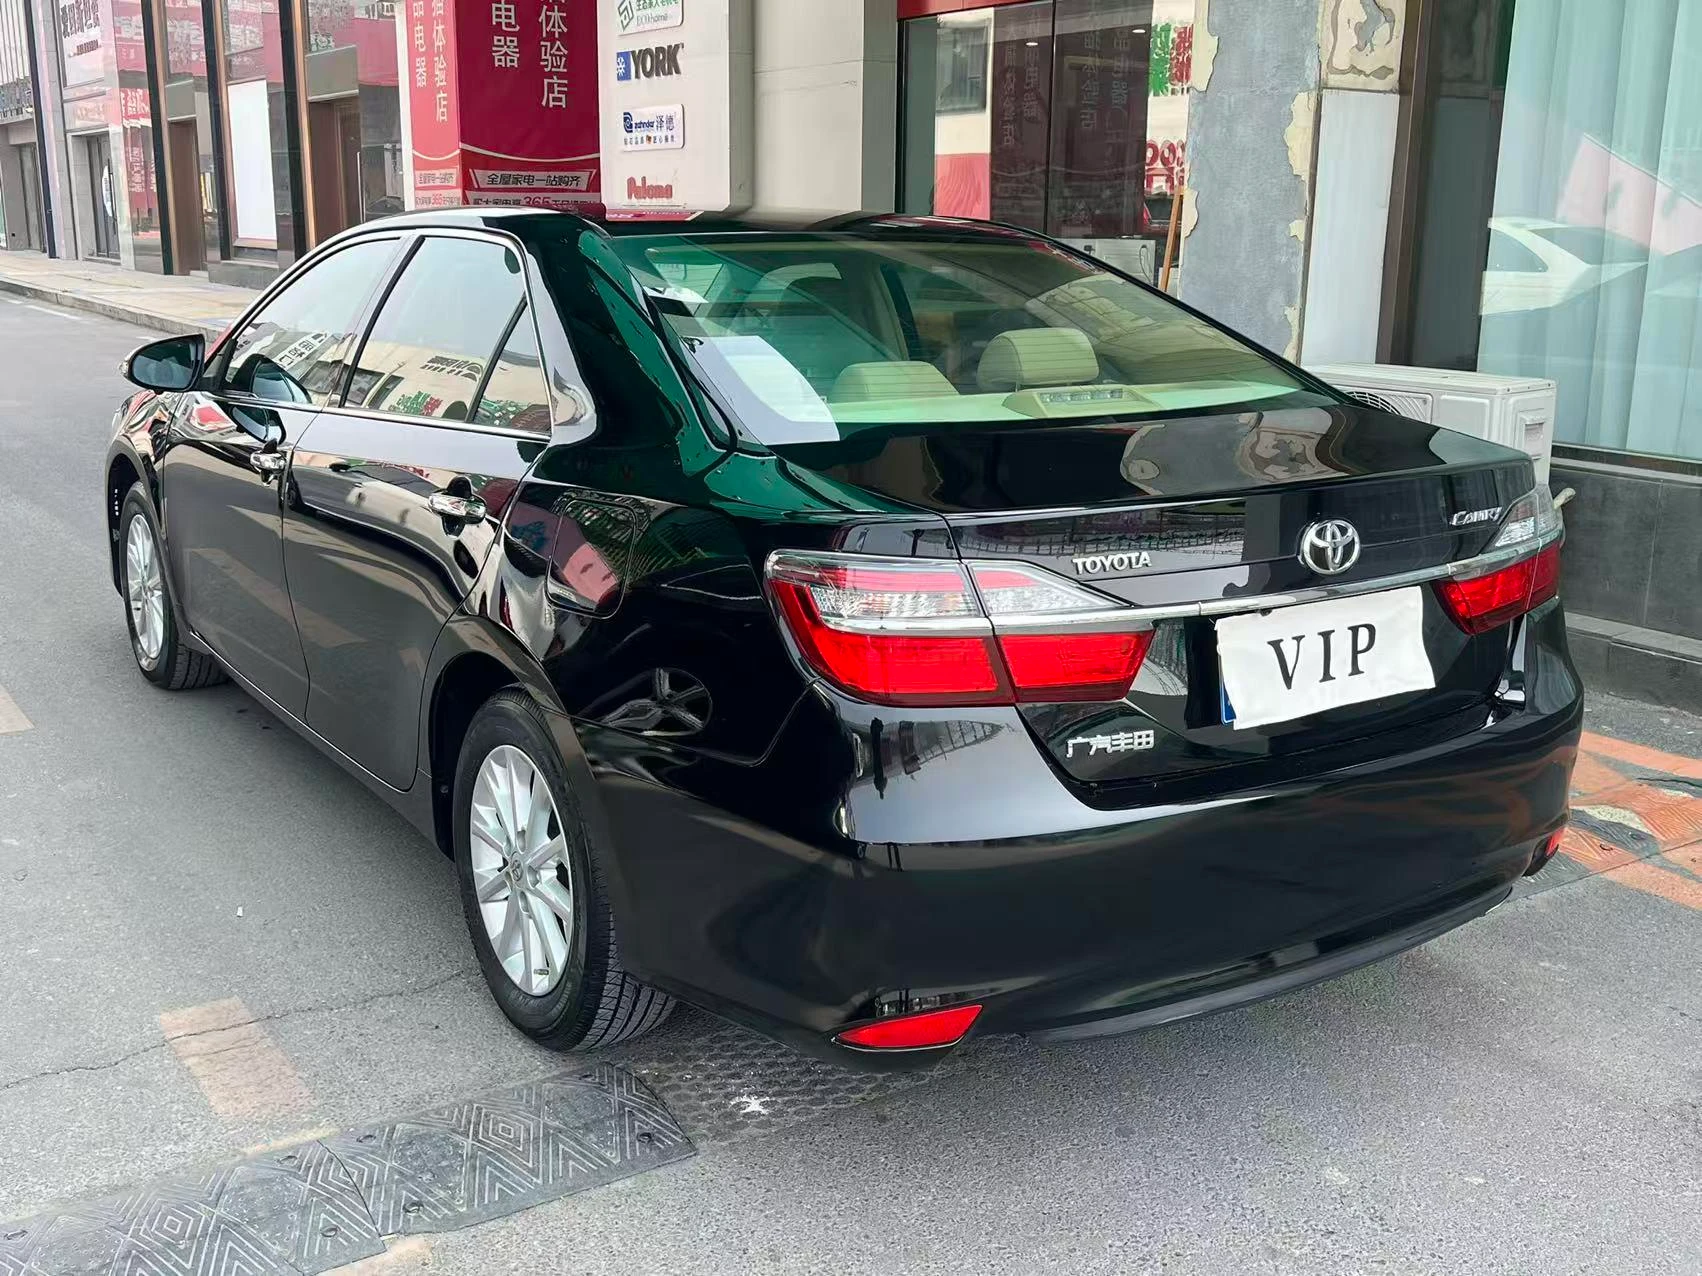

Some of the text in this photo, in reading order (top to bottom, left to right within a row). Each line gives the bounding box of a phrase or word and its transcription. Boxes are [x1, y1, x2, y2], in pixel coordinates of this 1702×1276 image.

[491, 0, 520, 68] 电器
[538, 0, 569, 108] 体验店
[632, 43, 682, 79] YORK
[487, 173, 581, 187] 全屋家电一站购齐
[627, 176, 673, 200] Paloma
[1072, 550, 1152, 576] TOYOTA
[1266, 622, 1378, 691] VIP
[1066, 729, 1155, 759] 广汽丰田
